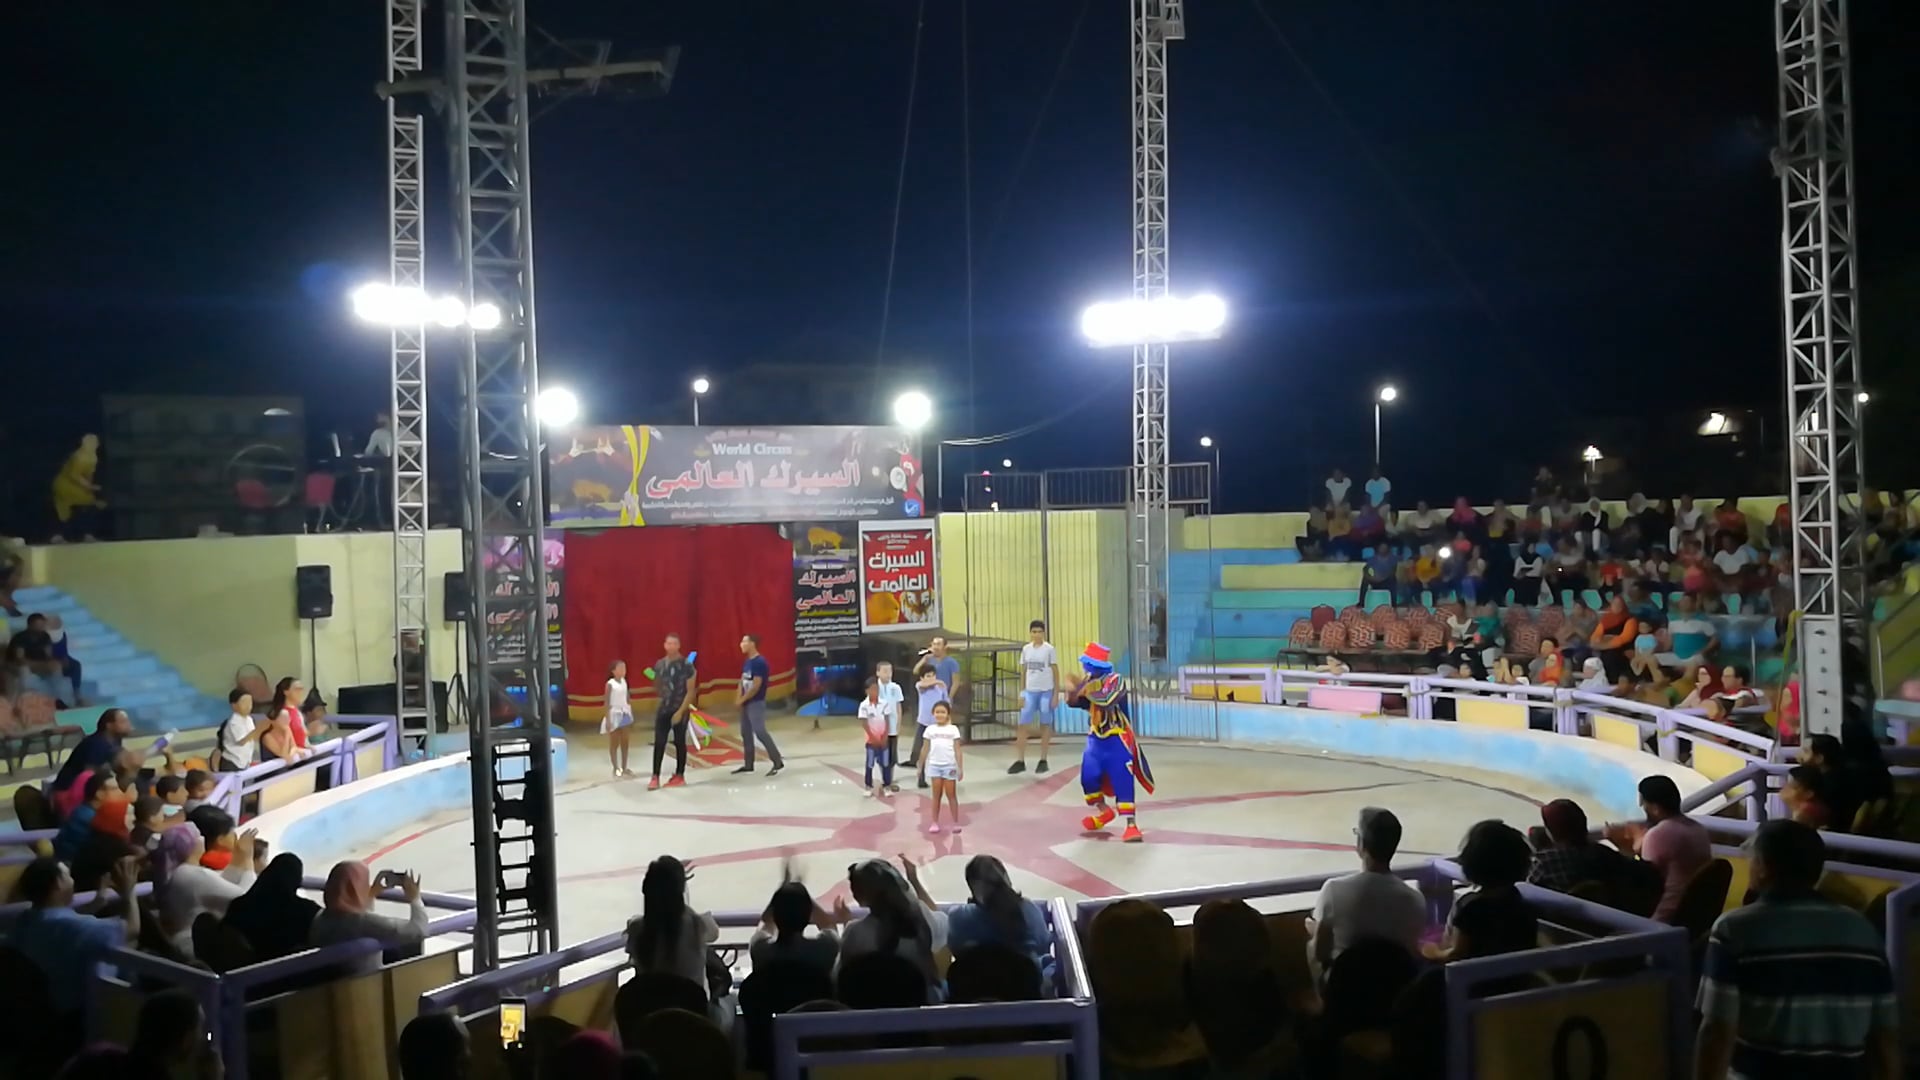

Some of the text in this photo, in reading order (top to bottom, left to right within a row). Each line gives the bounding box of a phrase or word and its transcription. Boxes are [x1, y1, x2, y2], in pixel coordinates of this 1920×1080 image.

[712, 442, 793, 456] World Circus
[760, 457, 861, 496] السيرك
[868, 550, 925, 573] السيرك
[798, 568, 857, 588] السيرك
